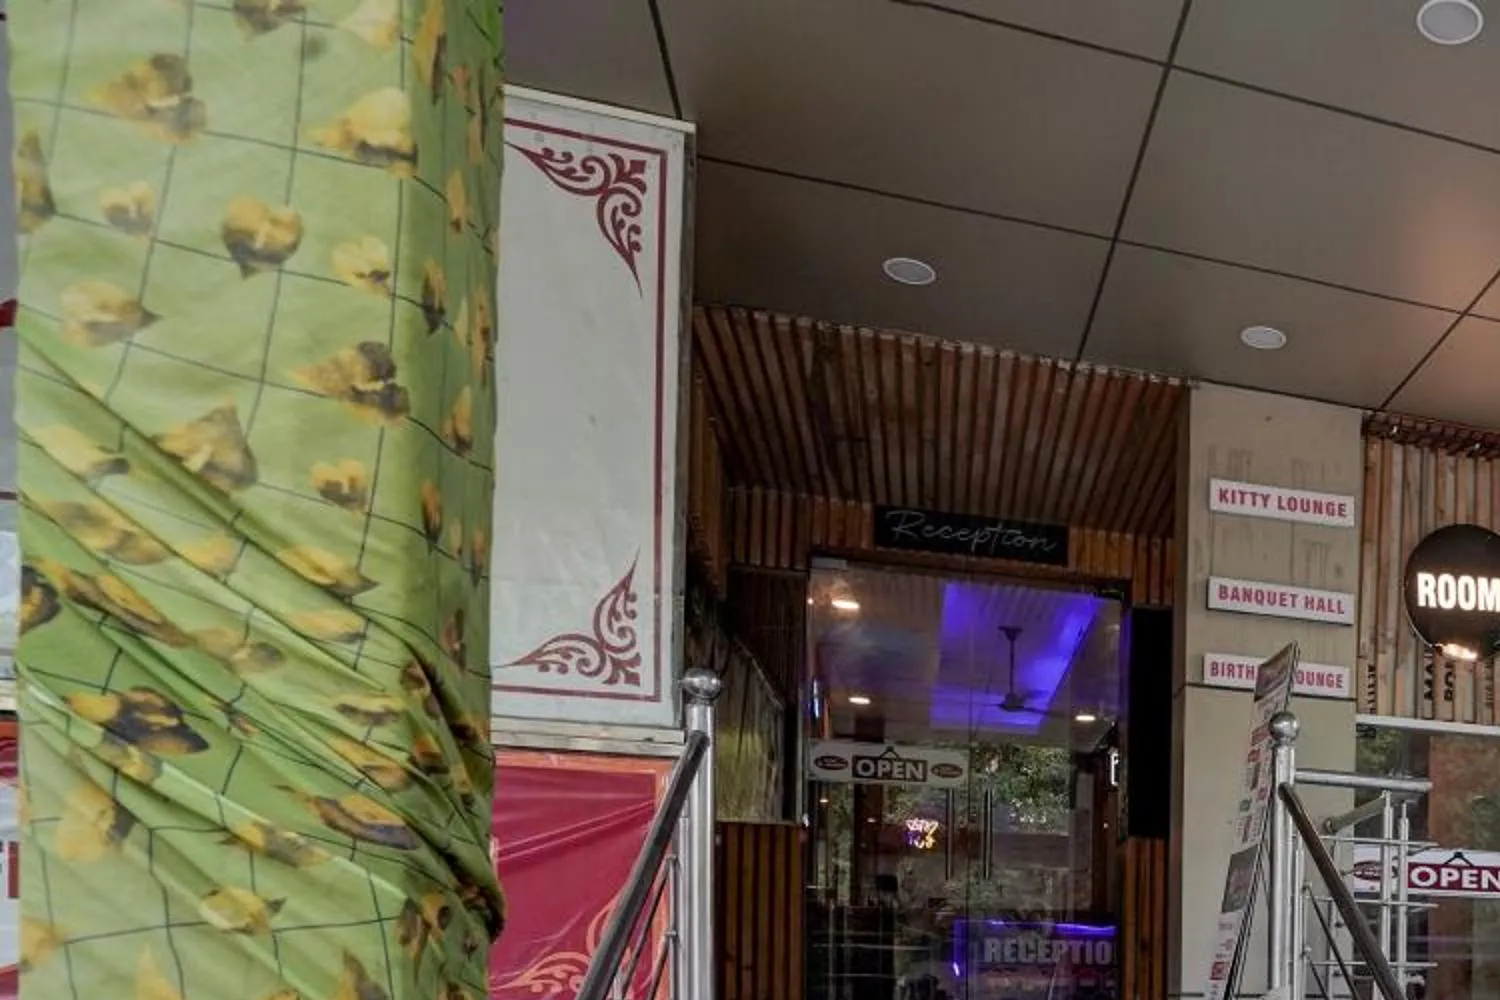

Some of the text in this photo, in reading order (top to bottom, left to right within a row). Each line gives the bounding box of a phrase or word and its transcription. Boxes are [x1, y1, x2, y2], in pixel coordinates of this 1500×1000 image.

[1218, 487, 1348, 519] KITTY LOUNGE
[885, 509, 1058, 553] Reception
[1217, 584, 1345, 615] BANQUET HALL
[1209, 660, 1257, 681] BIRTH
[1292, 667, 1345, 690] OUNGE
[855, 758, 925, 780] OPEN
[983, 937, 1118, 966] RECEPTIO
